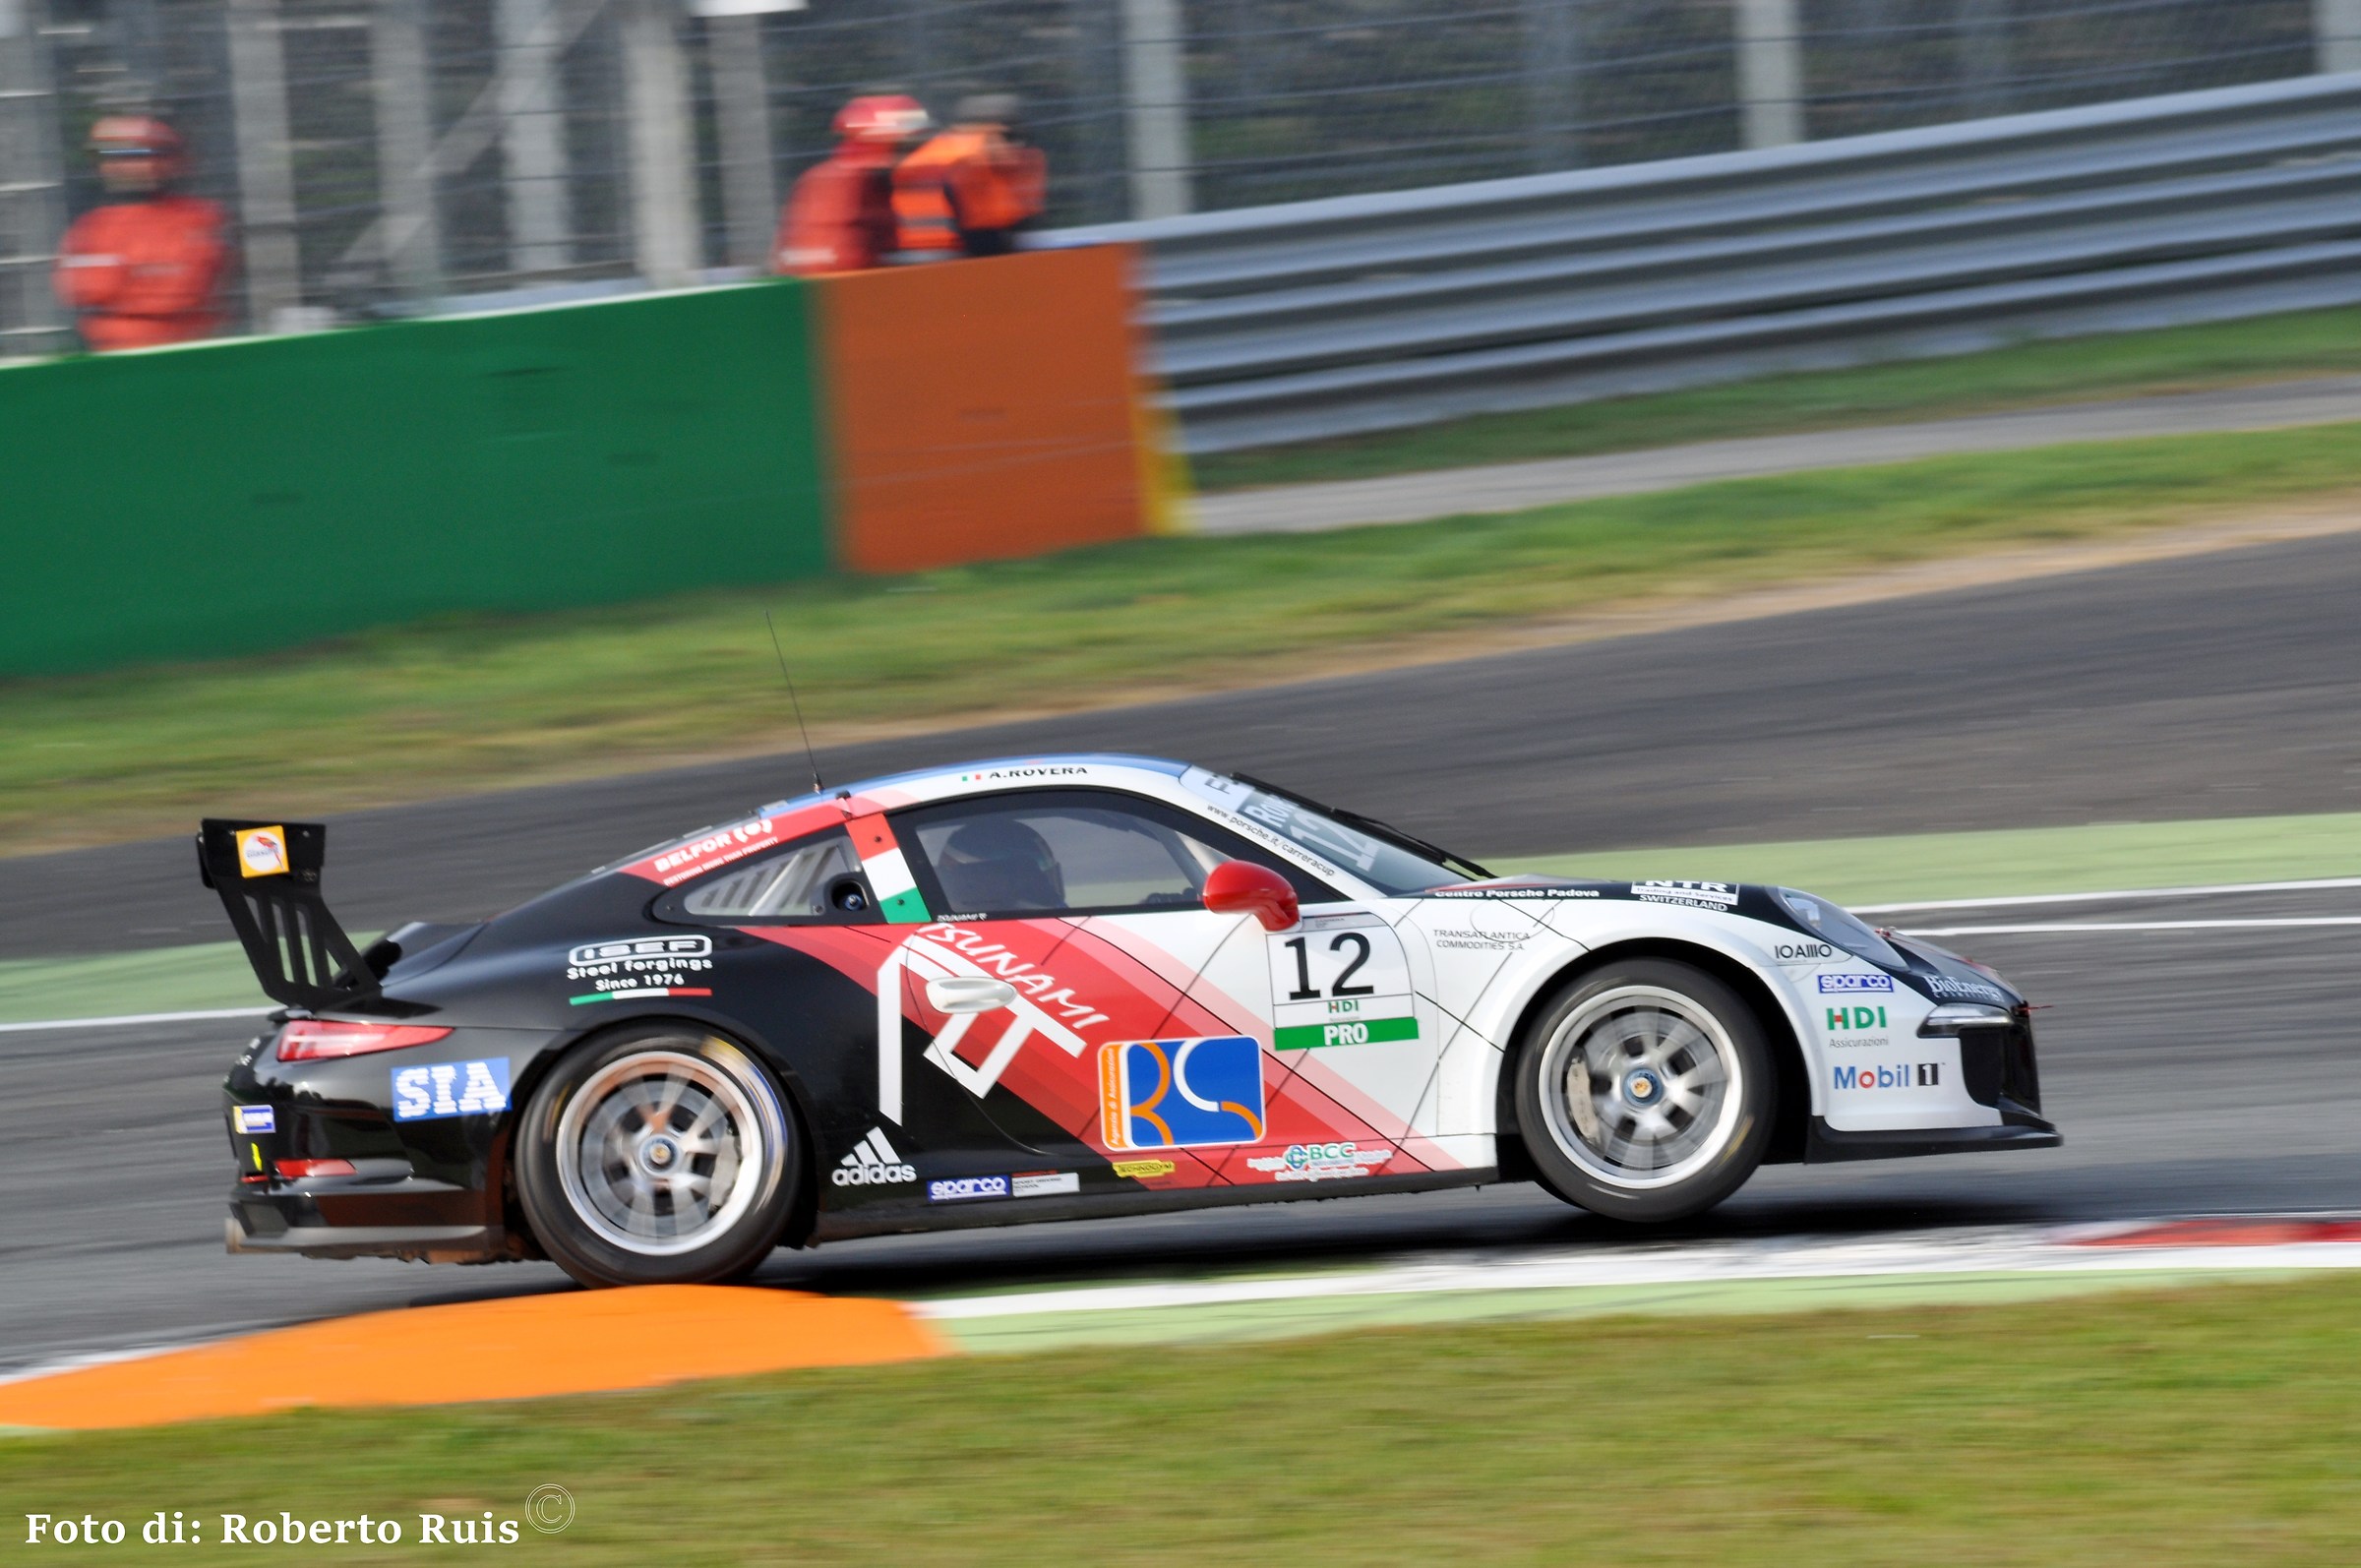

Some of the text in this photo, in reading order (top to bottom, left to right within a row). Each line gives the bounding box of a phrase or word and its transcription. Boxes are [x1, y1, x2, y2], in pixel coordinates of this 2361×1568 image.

[1206, 803, 1335, 877] www.porsche.it/carreracup
[653, 833, 733, 873] BELFOR
[1485, 888, 1544, 898] Porsche
[1547, 887, 1600, 897] Padova
[1639, 894, 1728, 912] SWITZERLAND
[584, 940, 697, 960] ISEF
[1436, 939, 1505, 950] COMMODITIES
[567, 957, 713, 980] Steel forgings
[916, 923, 1111, 1030] TSUNAMI
[1285, 933, 1374, 1001] 12
[595, 977, 638, 992] Since
[1822, 974, 1892, 993] sparco
[1328, 999, 1360, 1014] HDI
[1826, 1005, 1888, 1031] HDI
[1323, 1023, 1369, 1046] PRO
[1829, 1037, 1890, 1049] Assicurazioni
[1833, 1063, 1910, 1089] Mobil
[395, 1061, 507, 1118] SIA
[1308, 1144, 1356, 1161] BCC
[831, 1163, 917, 1187] adidas
[931, 1176, 1008, 1200] sparco
